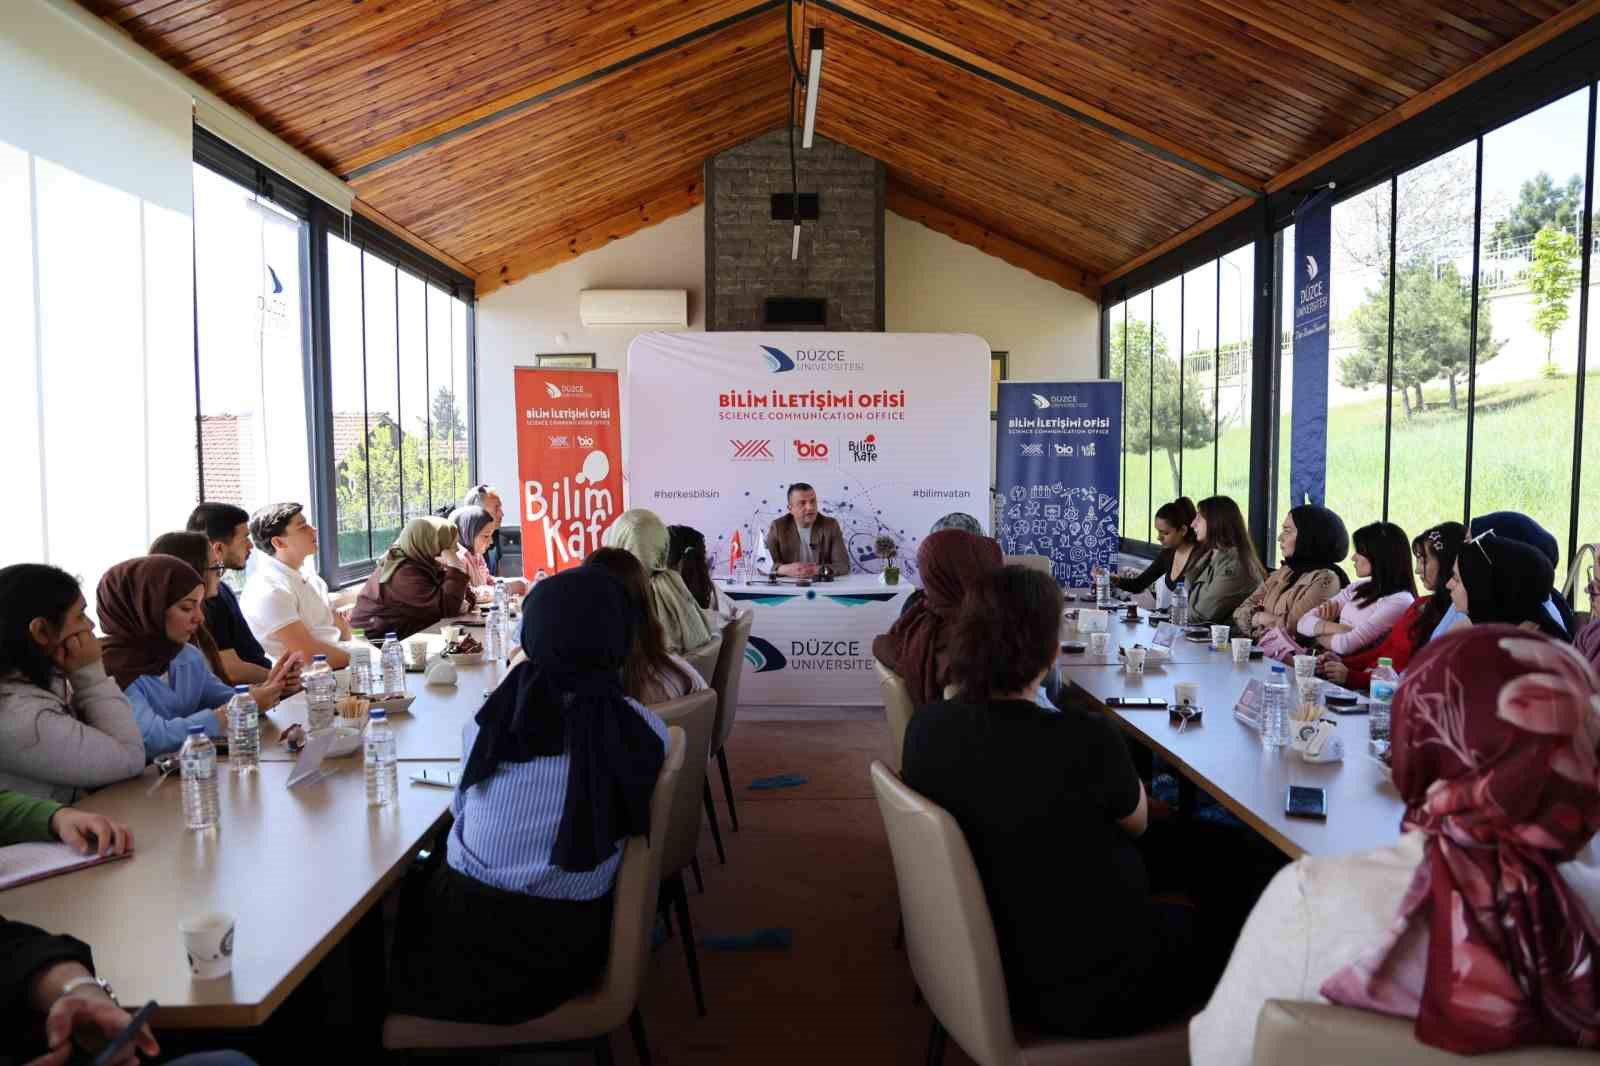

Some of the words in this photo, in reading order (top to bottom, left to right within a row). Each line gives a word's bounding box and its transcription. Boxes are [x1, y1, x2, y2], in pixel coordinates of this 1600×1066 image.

[719, 389, 768, 408] BİLİM
[772, 389, 854, 411] İLETİŞİMİ
[858, 389, 905, 408] OFİSİ
[719, 411, 764, 421] SCIENCE
[768, 411, 864, 421] COMMUNICATION
[866, 411, 905, 421] OFFICE
[1008, 417, 1036, 428] BİLİM
[1083, 417, 1110, 428] OFİSİ
[525, 474, 613, 521] Bilim
[653, 489, 720, 499] #herkesbilsin
[912, 489, 971, 499] #bilimvatan
[543, 509, 606, 568] Kaf
[791, 638, 860, 656] DÜZCE
